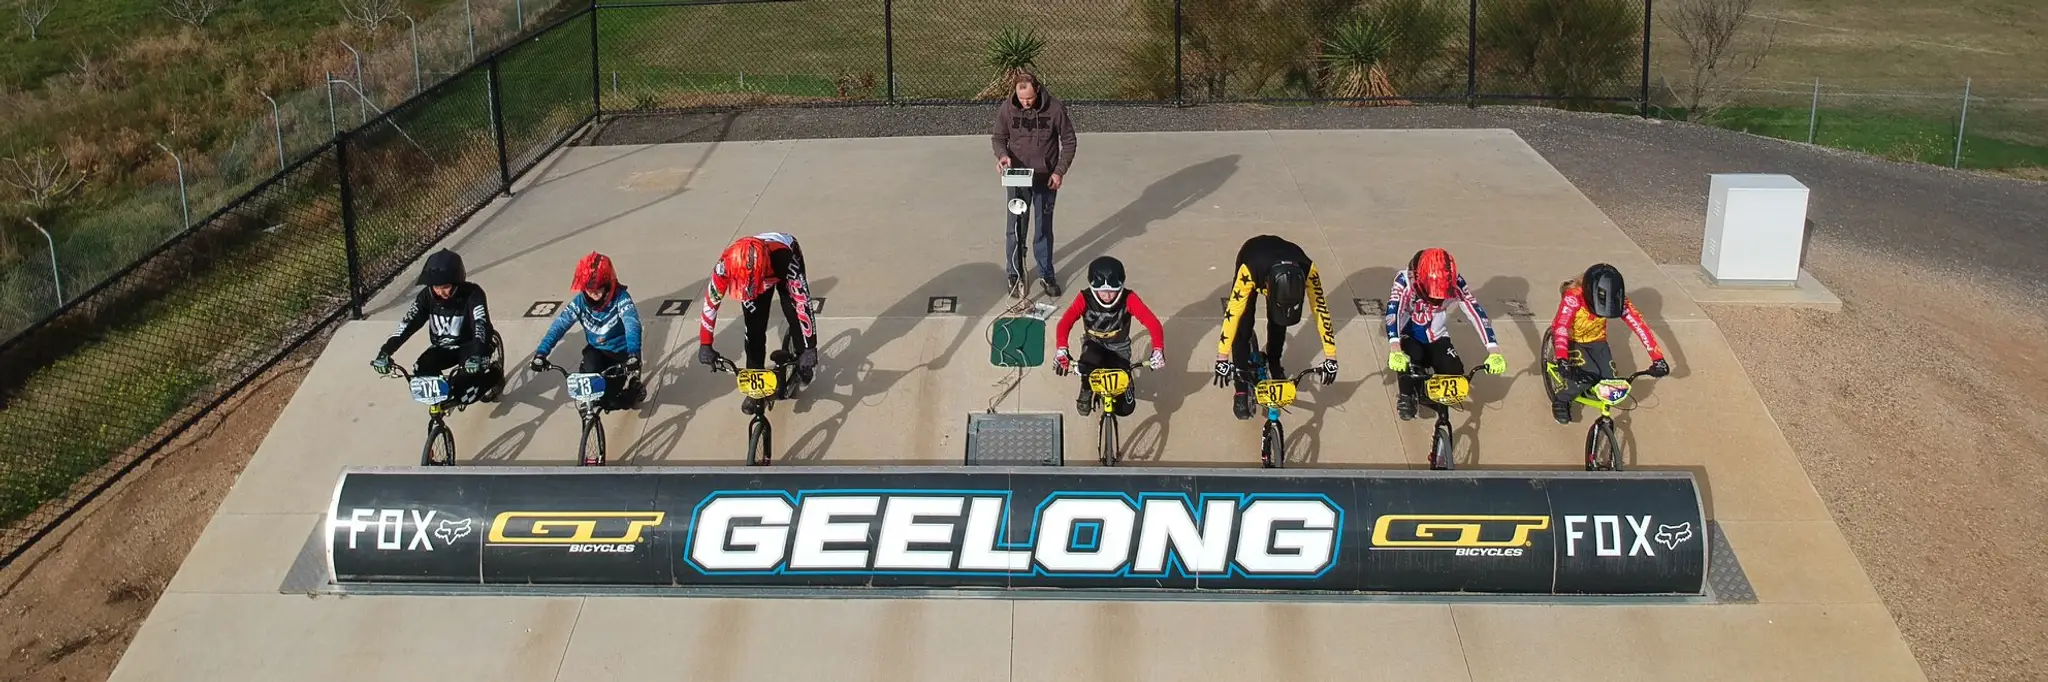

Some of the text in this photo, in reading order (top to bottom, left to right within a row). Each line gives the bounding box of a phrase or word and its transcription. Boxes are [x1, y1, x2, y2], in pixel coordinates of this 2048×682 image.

[579, 377, 592, 396] 13
[750, 373, 765, 391] 85
[1102, 373, 1119, 392] 117
[1442, 379, 1458, 397] 23
[1269, 384, 1284, 402] 87
[349, 508, 437, 551] FOX
[488, 511, 665, 543] GT
[690, 495, 1337, 573] GEELONG
[1373, 515, 1550, 547] GT
[1564, 515, 1655, 557] FOX
[569, 543, 636, 553] BICYCLES
[1455, 547, 1525, 557] BICYCLES
